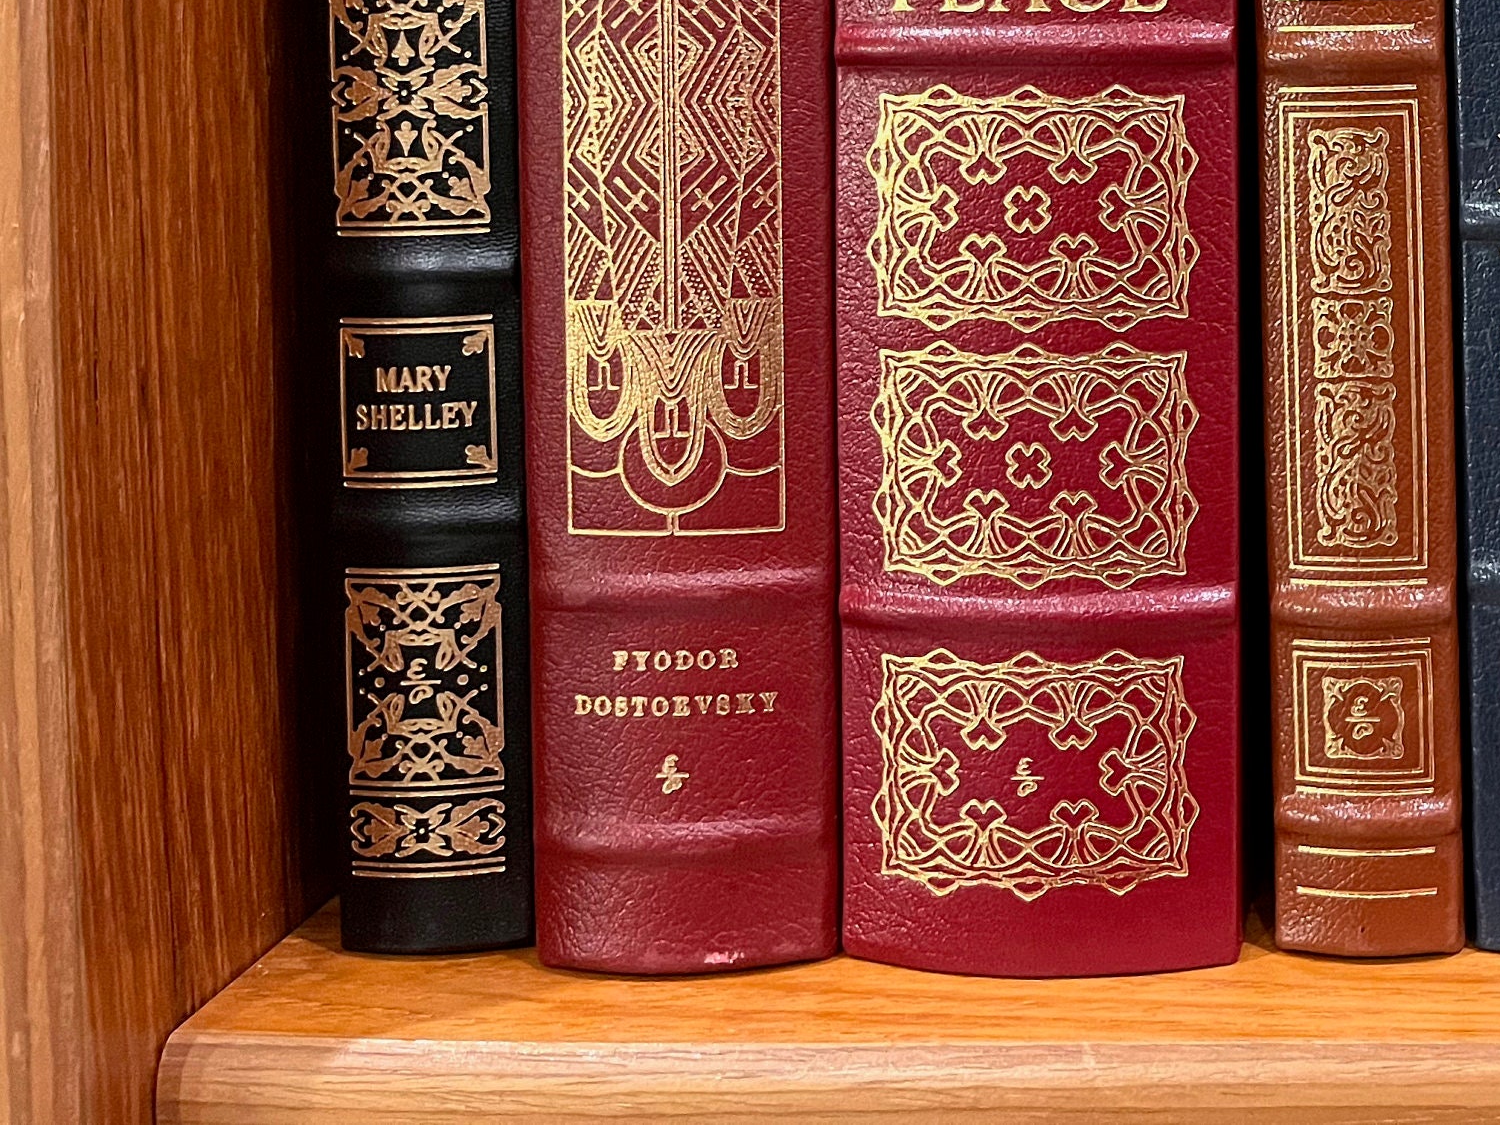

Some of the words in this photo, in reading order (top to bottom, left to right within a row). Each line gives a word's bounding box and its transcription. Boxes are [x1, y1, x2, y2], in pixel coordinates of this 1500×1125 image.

[376, 364, 452, 394] MARY
[356, 400, 478, 431] SHELLEY
[612, 648, 739, 672] FYODOR
[574, 691, 778, 718] DOSTOEVSKY
